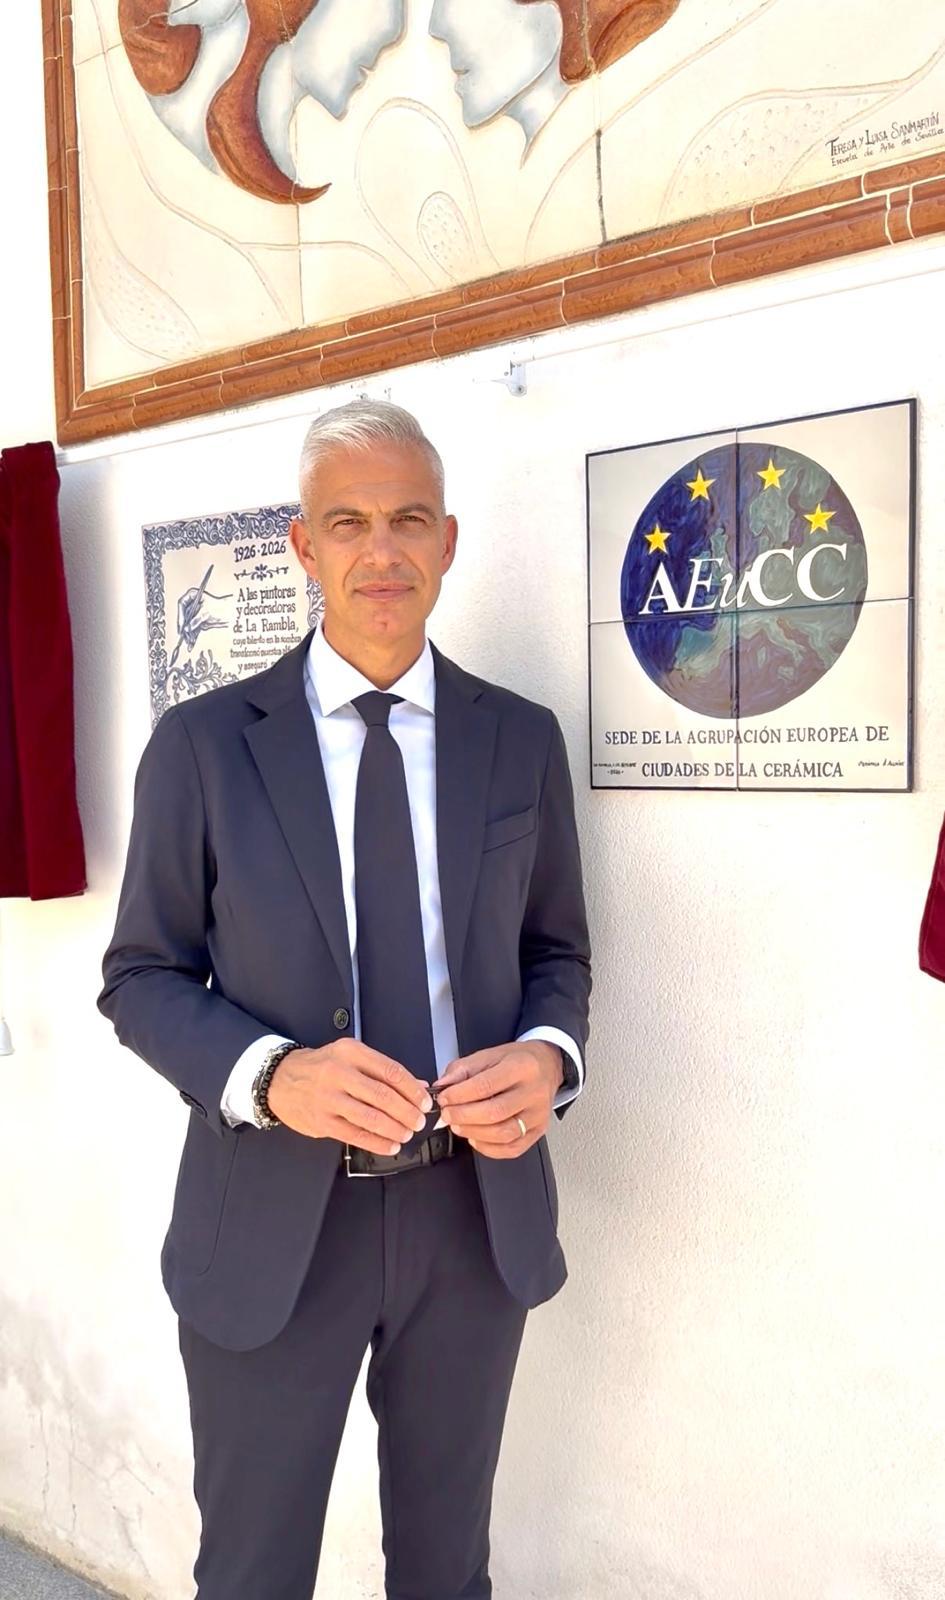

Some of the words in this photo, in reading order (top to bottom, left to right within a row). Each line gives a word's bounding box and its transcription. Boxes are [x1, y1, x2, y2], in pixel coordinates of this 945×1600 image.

[825, 136, 858, 157] TERESA
[865, 129, 888, 145] LUISA
[901, 136, 911, 146] de
[915, 128, 945, 141] Sevilla
[638, 542, 848, 615] AEuCC
[237, 587, 246, 603] A
[246, 586, 259, 602] las
[259, 586, 297, 604] pintoras
[236, 606, 244, 620] y
[243, 601, 297, 617] decoradoras
[233, 620, 243, 634] de
[245, 618, 257, 633] La
[261, 616, 300, 633] Rambla,
[237, 663, 244, 675] y
[604, 730, 638, 745] SEDE
[641, 730, 662, 745] DE
[665, 730, 683, 744] LA
[686, 726, 782, 744] AGRUPACIÓN
[786, 726, 859, 743] EUROPEA
[866, 725, 890, 741] DE
[641, 762, 709, 777] CIUDADES
[714, 762, 735, 777] DE
[738, 762, 758, 777] LA
[763, 758, 844, 777] CERÁMICA
